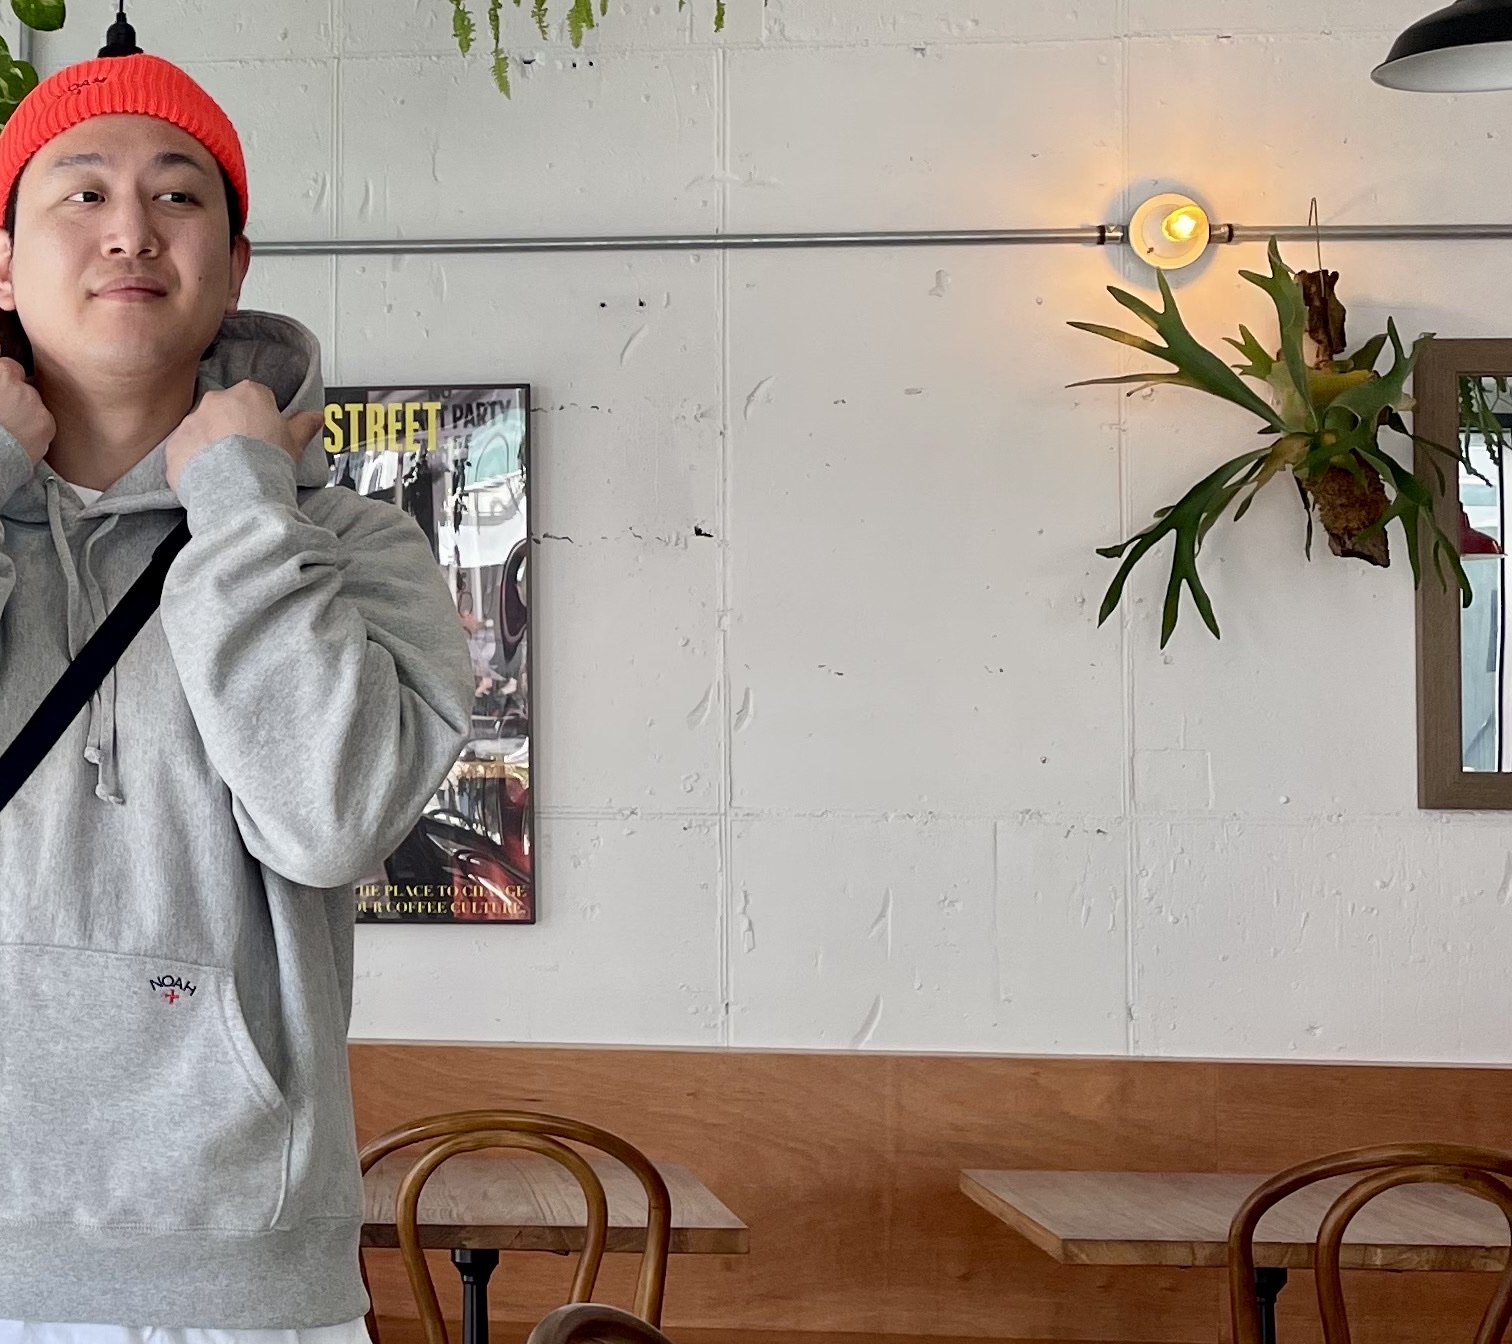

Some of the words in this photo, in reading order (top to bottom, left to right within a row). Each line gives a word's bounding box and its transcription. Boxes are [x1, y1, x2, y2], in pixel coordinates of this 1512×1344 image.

[452, 400, 512, 429] PARTY
[324, 401, 442, 453] STREET
[357, 884, 381, 897] HE
[384, 884, 434, 897] PLACE
[437, 884, 459, 897] TO
[462, 884, 527, 897] CHGE
[386, 901, 448, 914] COFFEE
[149, 974, 197, 997] NOAH
